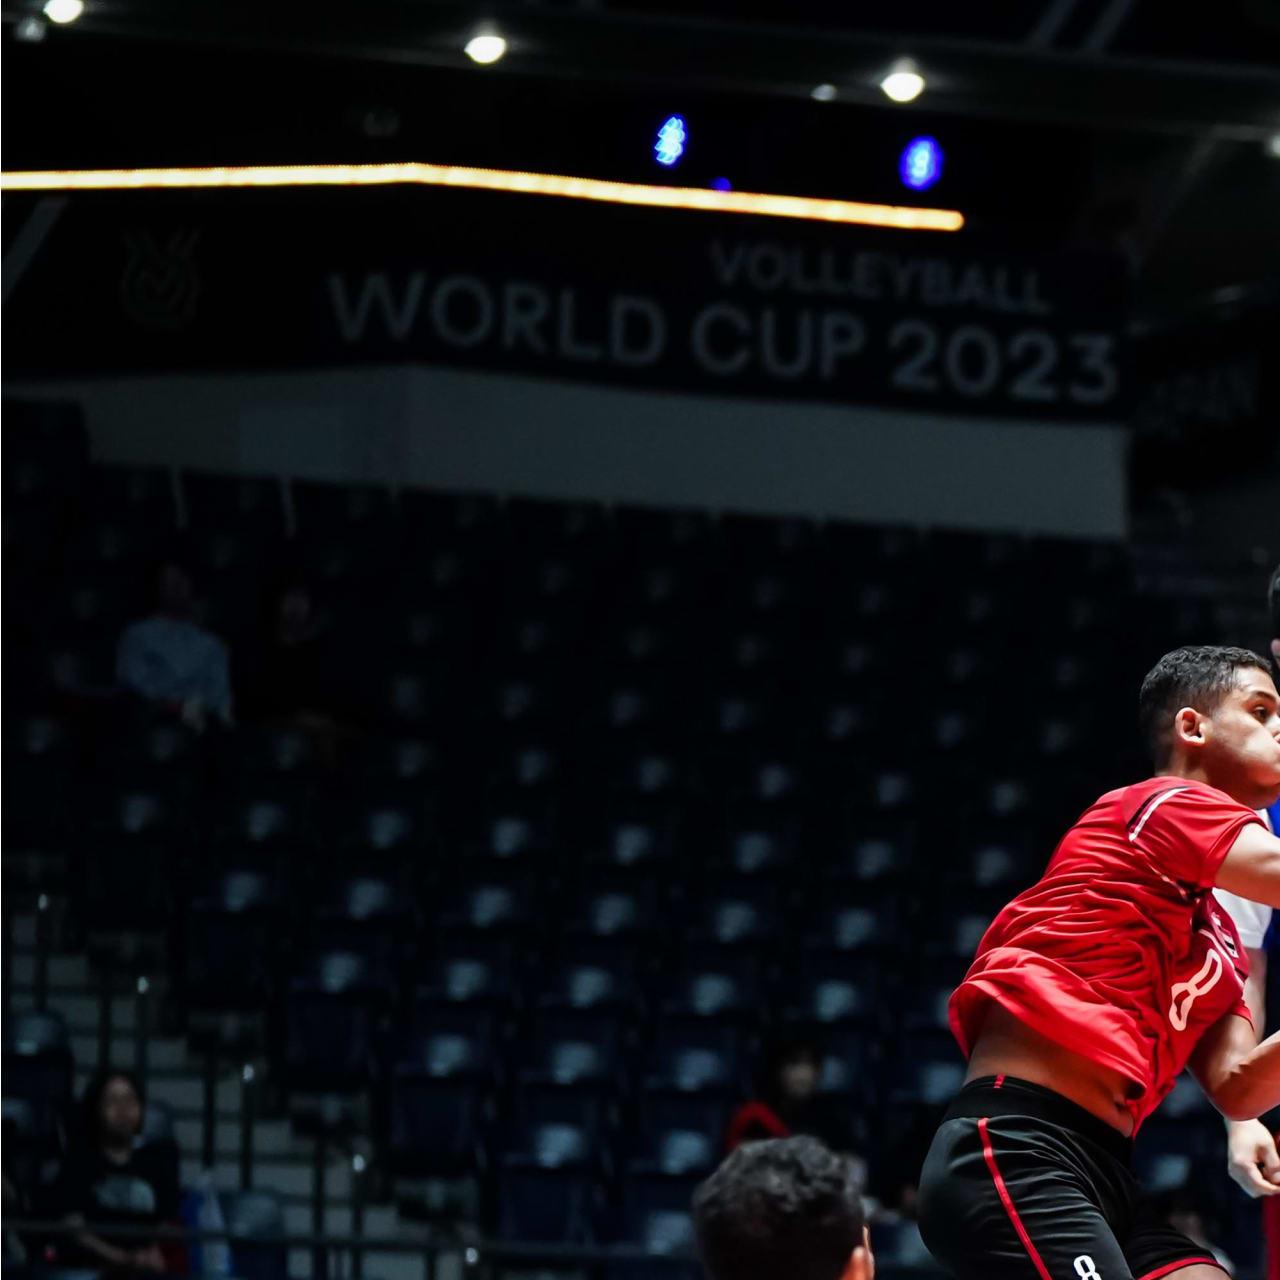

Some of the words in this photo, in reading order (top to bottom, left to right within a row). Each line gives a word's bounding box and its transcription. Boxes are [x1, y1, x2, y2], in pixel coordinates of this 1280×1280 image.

[708, 238, 1056, 317] VOLLEYBALL
[325, 268, 673, 368] WORLD
[690, 300, 868, 383] CUP
[886, 318, 1124, 407] 2023
[1169, 948, 1222, 1031] 8
